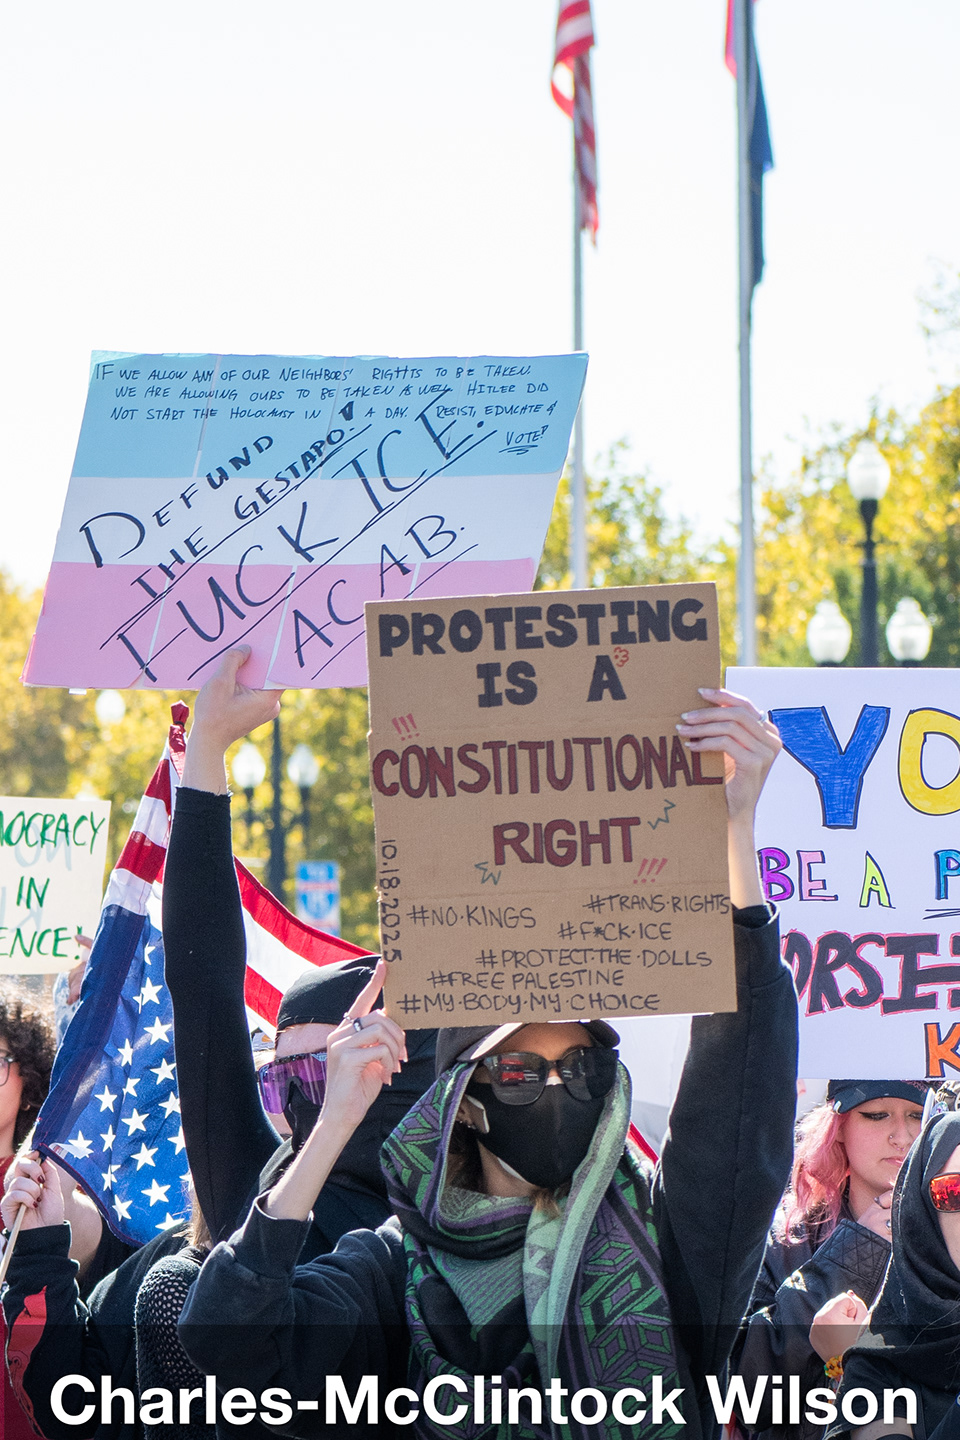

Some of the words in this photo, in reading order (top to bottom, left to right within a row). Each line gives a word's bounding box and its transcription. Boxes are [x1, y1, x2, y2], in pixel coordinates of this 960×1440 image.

[96, 364, 114, 381] IF
[119, 369, 141, 381] WE
[147, 369, 187, 381] ALLOW
[192, 369, 214, 383] ANY
[220, 369, 238, 381] OF
[242, 368, 271, 381] OUR
[372, 365, 422, 380] RIGHTS
[435, 367, 448, 378] TO
[456, 368, 475, 378] BE
[115, 386, 137, 398] WE
[144, 386, 171, 399] ARE
[179, 389, 238, 401] ALLOWING
[249, 390, 285, 402] OURS
[296, 388, 310, 399] TO
[320, 387, 336, 400] BE
[343, 385, 394, 398] TAKEN
[399, 384, 413, 397] AS
[467, 380, 516, 395] HITLER
[527, 382, 549, 394] DID
[110, 407, 139, 420] NOT
[146, 407, 186, 420] START
[192, 407, 218, 419] THE
[230, 406, 295, 420] HOLOCAUST
[304, 409, 322, 419] IN
[364, 407, 376, 418] A
[385, 407, 408, 418] DAY.
[436, 404, 476, 419] RESIST,
[484, 404, 544, 417] EDUCATE
[79, 435, 274, 569] DEFUND
[130, 525, 209, 599] THE
[116, 501, 339, 683] FUCK
[378, 598, 708, 657] PROTESTING
[476, 660, 538, 708] IS
[586, 655, 626, 702] A
[372, 734, 724, 799] CONSTITUTIONAL
[492, 817, 641, 867] RIGHT
[16, 876, 50, 909] IN
[757, 847, 838, 902] BE
[859, 851, 896, 909] A
[427, 970, 505, 990] #FREE
[512, 969, 625, 991] PALESTINE
